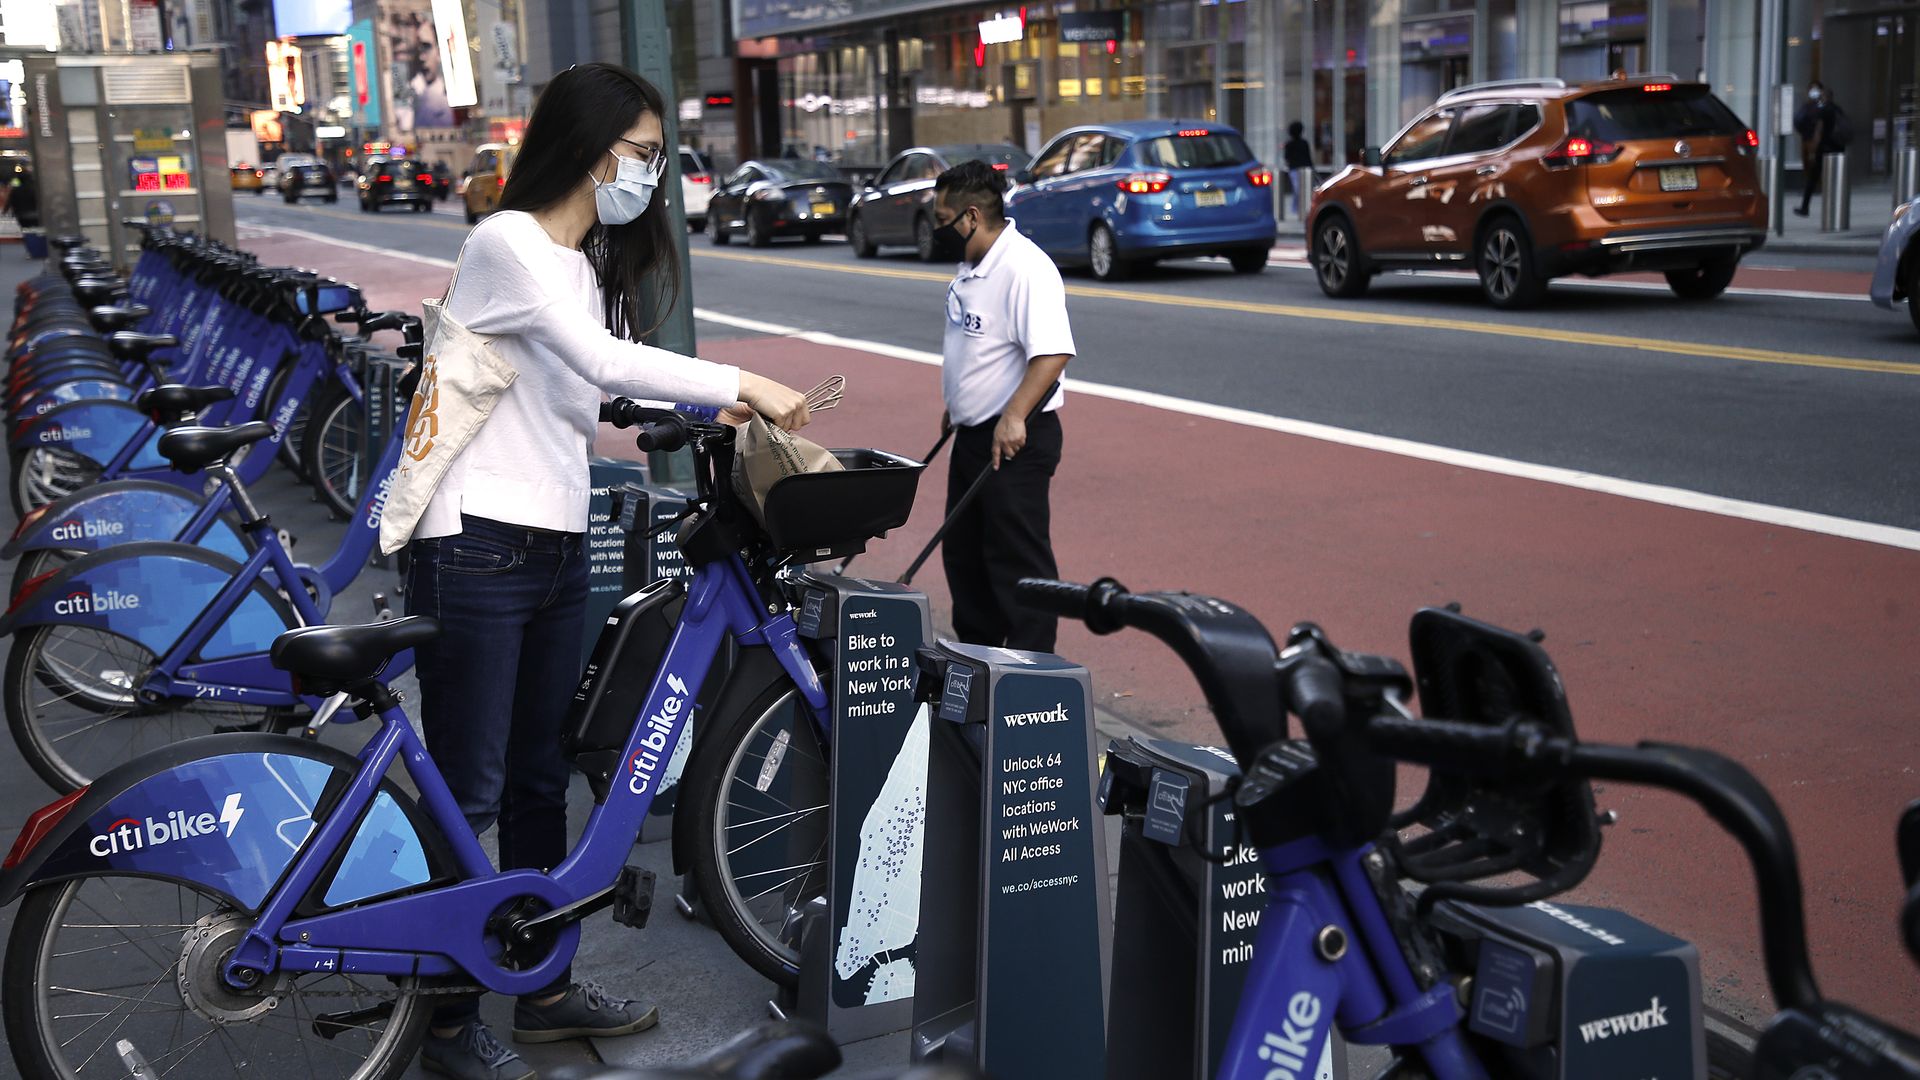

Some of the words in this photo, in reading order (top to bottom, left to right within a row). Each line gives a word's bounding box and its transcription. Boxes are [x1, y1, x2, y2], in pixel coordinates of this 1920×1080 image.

[52, 523, 82, 540] citi
[84, 519, 123, 537] bike
[590, 527, 606, 535] NYC
[657, 565, 681, 577] New
[55, 595, 90, 614] citi
[92, 591, 139, 612] bike
[849, 609, 877, 619] wework
[848, 635, 876, 650] Bike
[880, 633, 895, 647] to
[848, 656, 881, 672] work
[885, 655, 897, 669] in
[901, 657, 909, 668] a
[848, 680, 877, 695] New
[881, 676, 911, 692] York
[848, 701, 895, 717] minute
[1004, 702, 1069, 727] wework
[640, 696, 682, 753] bike
[629, 751, 659, 794] citi
[1003, 754, 1043, 772] Unlock
[1046, 753, 1061, 767] 64
[1003, 779, 1026, 795] NYC
[1030, 776, 1063, 791] office
[1002, 799, 1056, 817] locations
[90, 824, 143, 857] citi
[146, 810, 216, 846] bike
[1002, 824, 1027, 840] with
[1030, 817, 1079, 836] WeWork
[1002, 847, 1017, 862] All
[1020, 844, 1061, 860] Access
[1002, 874, 1078, 894] we.co/accessnyc
[1222, 872, 1265, 899] work
[1223, 910, 1260, 932] New
[1222, 940, 1253, 965] min
[1578, 996, 1668, 1044] wework
